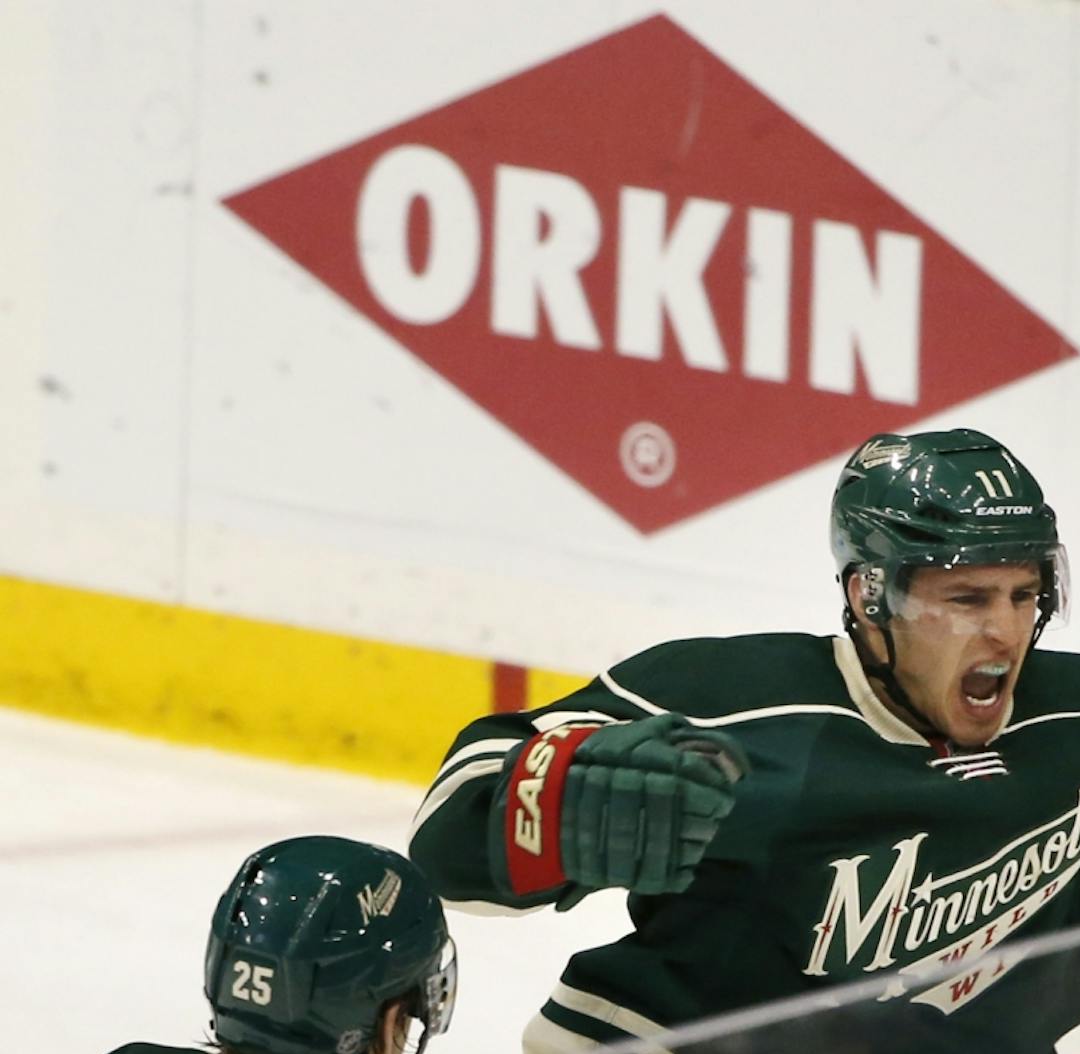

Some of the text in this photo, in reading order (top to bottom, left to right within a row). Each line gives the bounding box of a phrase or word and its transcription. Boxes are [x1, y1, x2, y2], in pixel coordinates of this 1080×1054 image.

[355, 143, 923, 406] ORKIN
[975, 470, 1014, 498] 11
[975, 505, 1033, 516] EASTON
[232, 961, 274, 1006] 25
